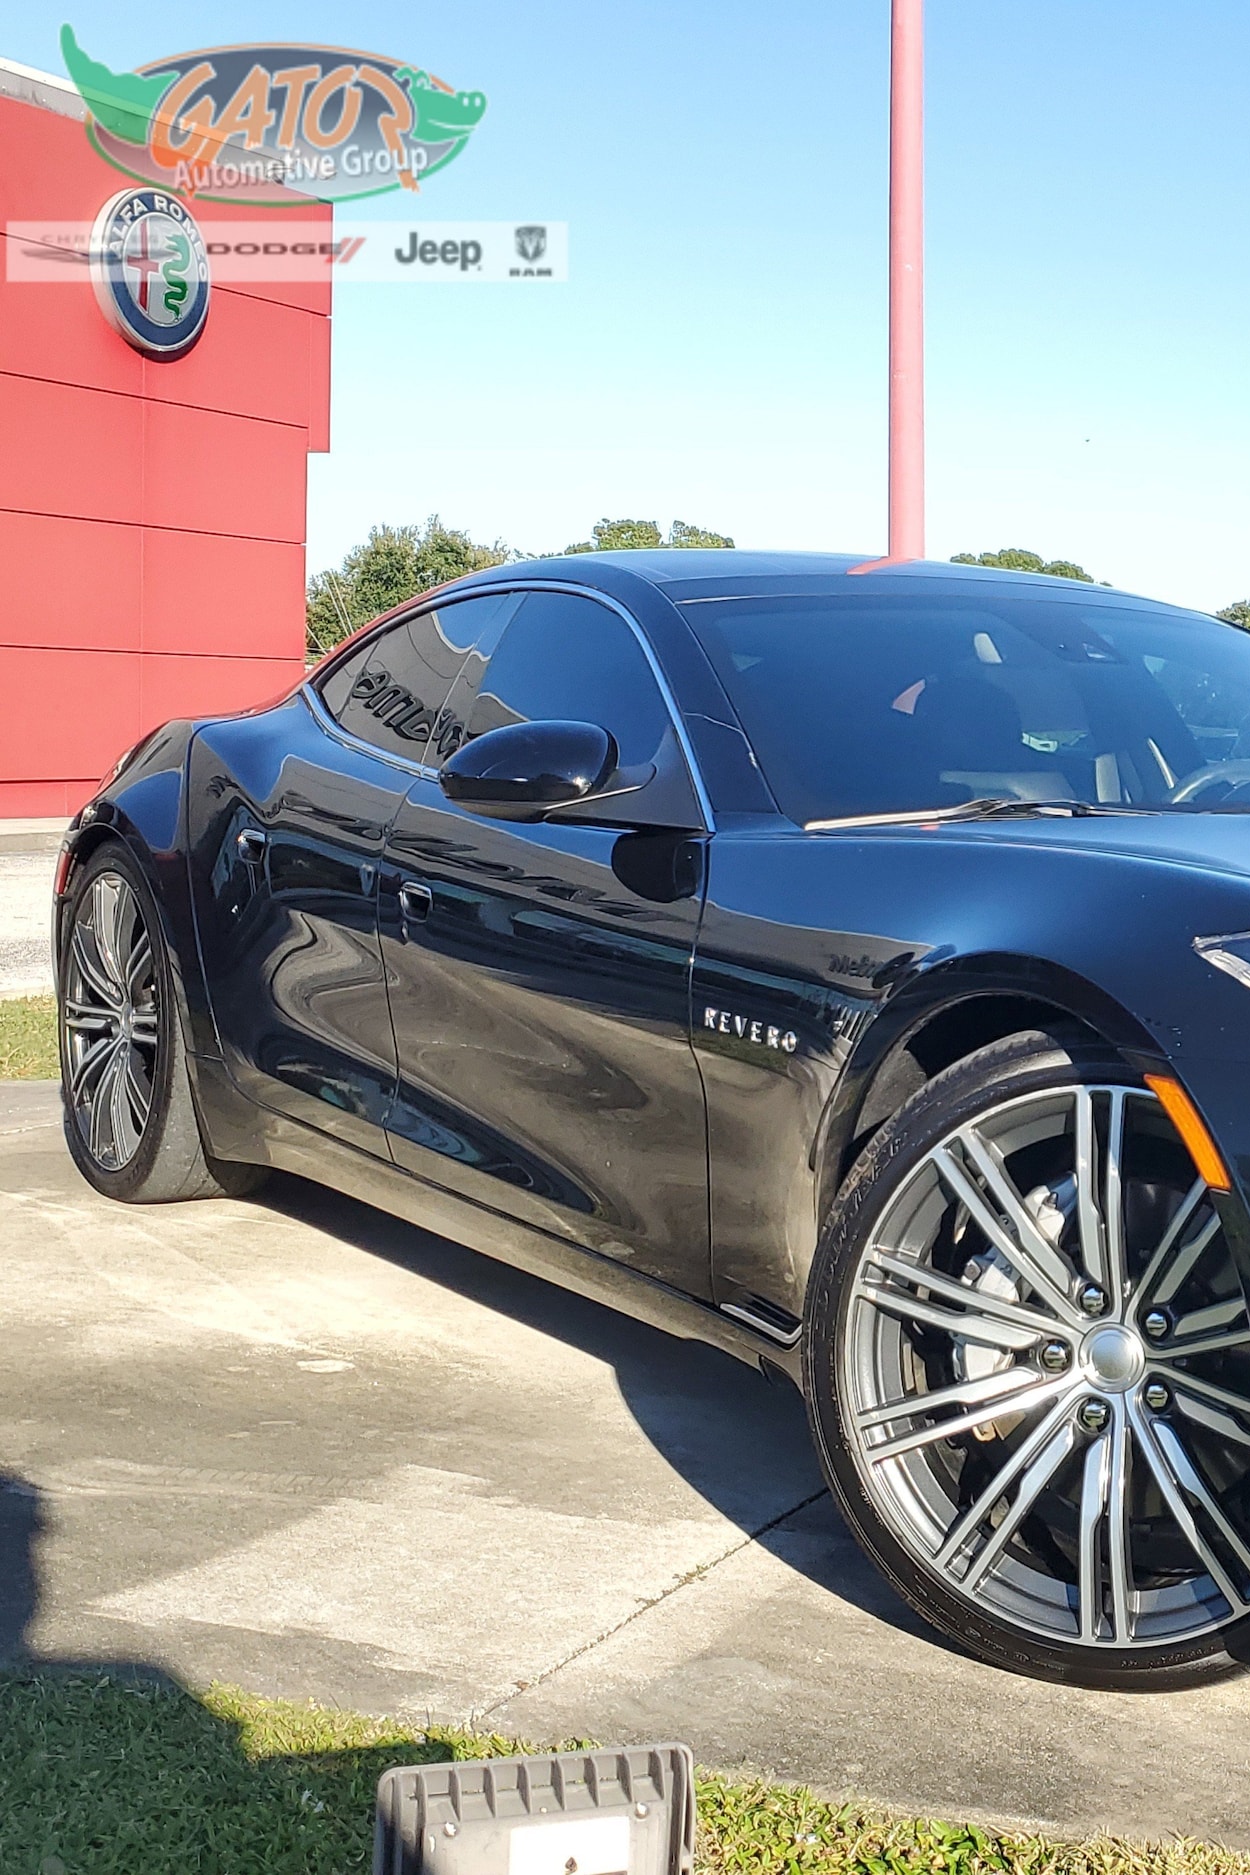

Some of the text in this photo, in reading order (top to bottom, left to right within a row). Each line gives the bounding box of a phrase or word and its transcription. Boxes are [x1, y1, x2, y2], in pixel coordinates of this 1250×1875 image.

[108, 194, 209, 282] ALFA ROMEO
[703, 1006, 797, 1053] REVERO
